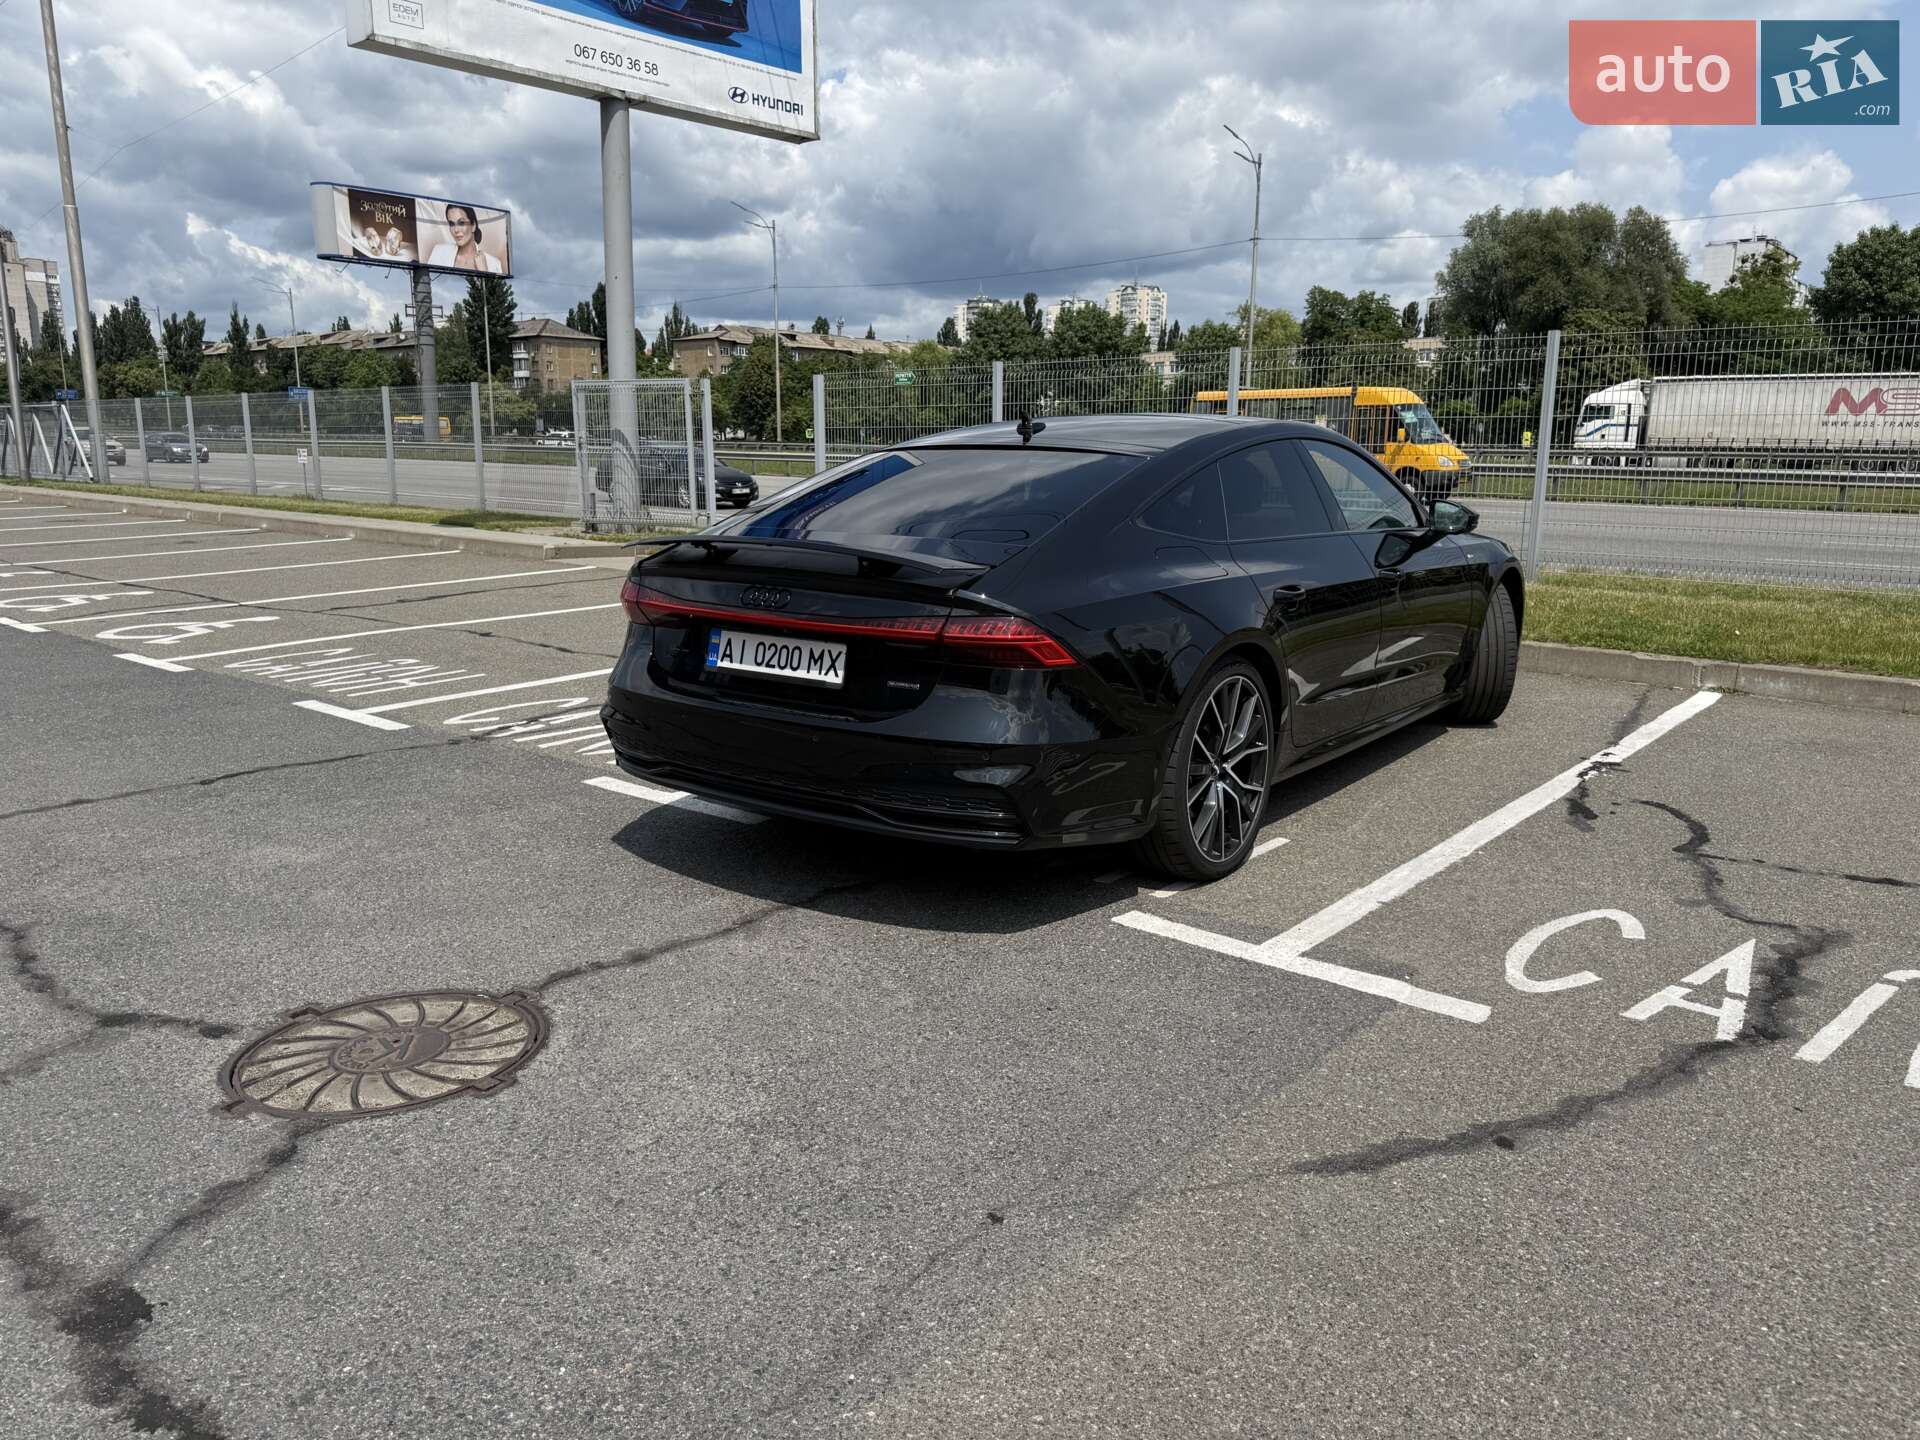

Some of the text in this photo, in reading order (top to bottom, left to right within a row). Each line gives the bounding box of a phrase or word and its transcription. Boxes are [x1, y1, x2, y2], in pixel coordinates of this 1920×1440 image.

[574, 43, 597, 61] 067
[600, 51, 623, 68] 650
[626, 57, 641, 72] 36
[644, 61, 659, 76] 58
[752, 93, 803, 116] HYUNDAI
[720, 637, 746, 665] AI
[754, 641, 803, 672] 0200
[806, 647, 843, 678] MX
